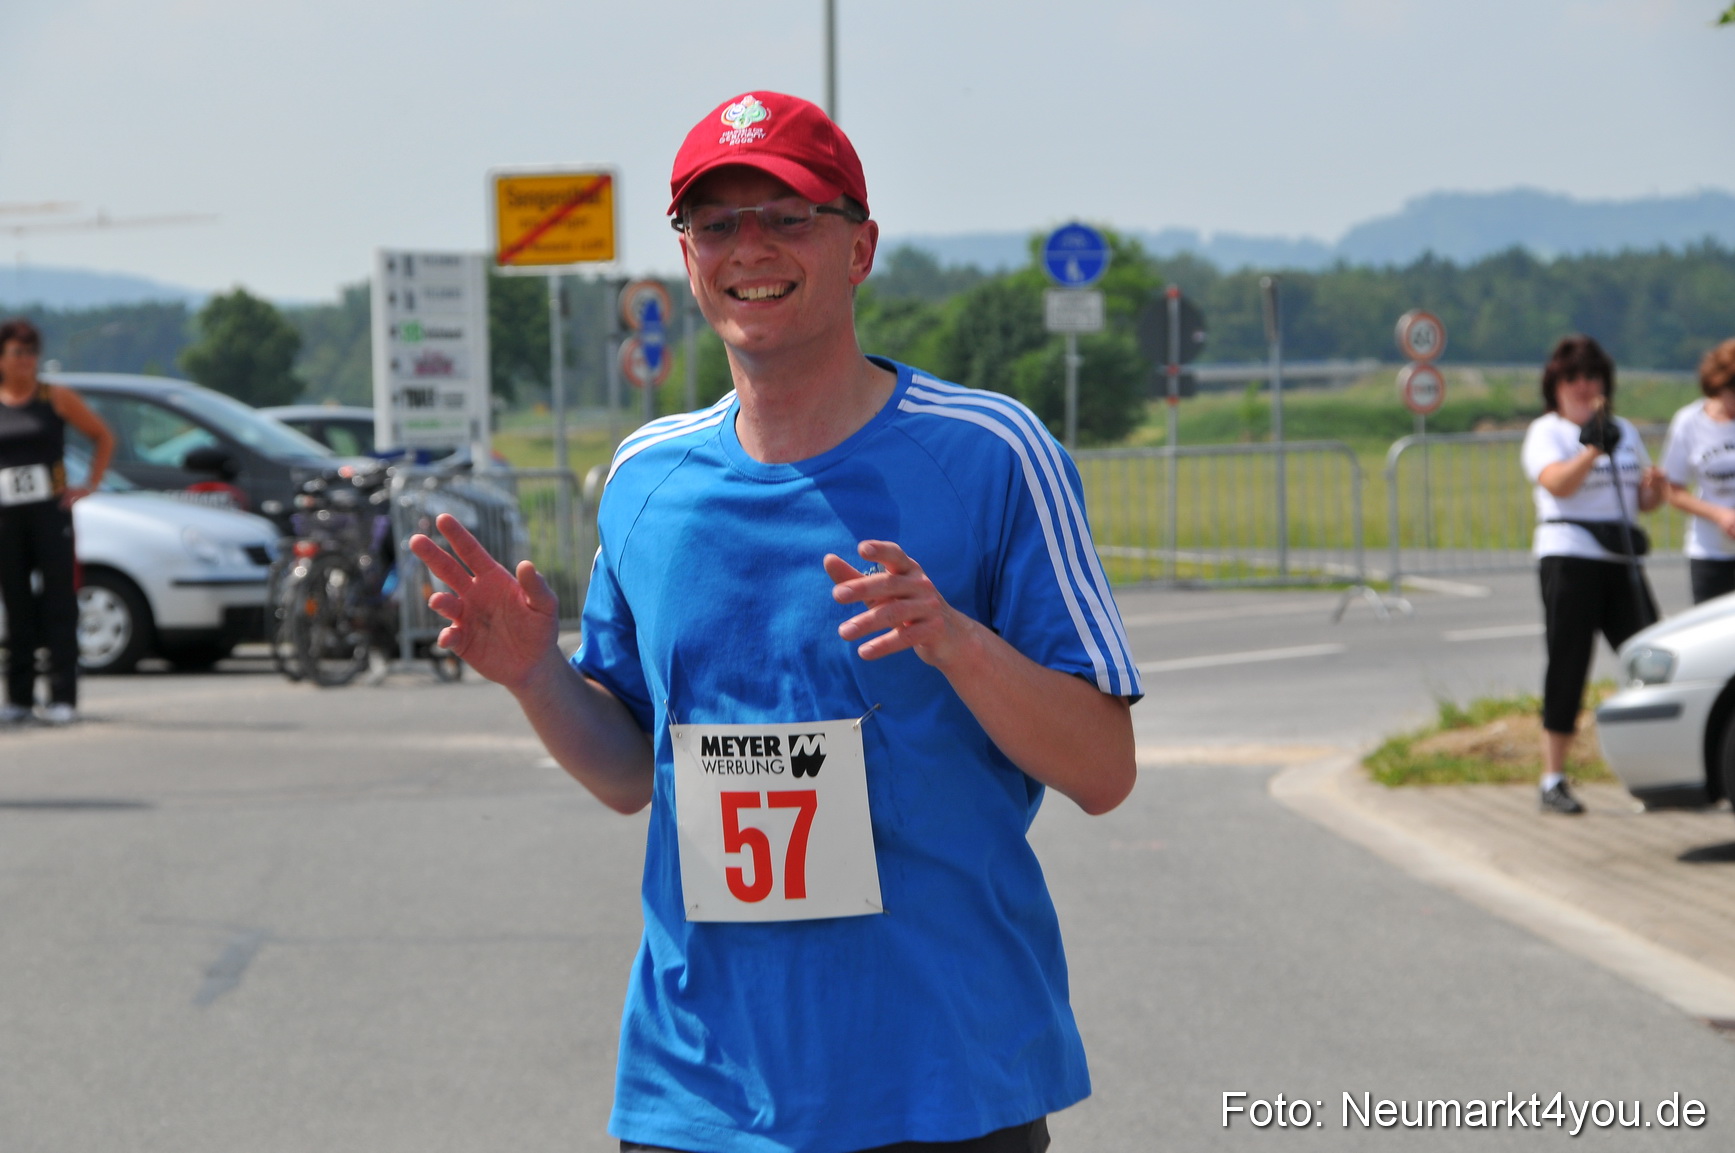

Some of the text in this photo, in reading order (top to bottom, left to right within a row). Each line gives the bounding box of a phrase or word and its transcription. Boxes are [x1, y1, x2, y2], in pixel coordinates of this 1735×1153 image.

[701, 735, 783, 757] MEYER
[702, 759, 785, 775] WERBUNG
[720, 789, 818, 904] 57
